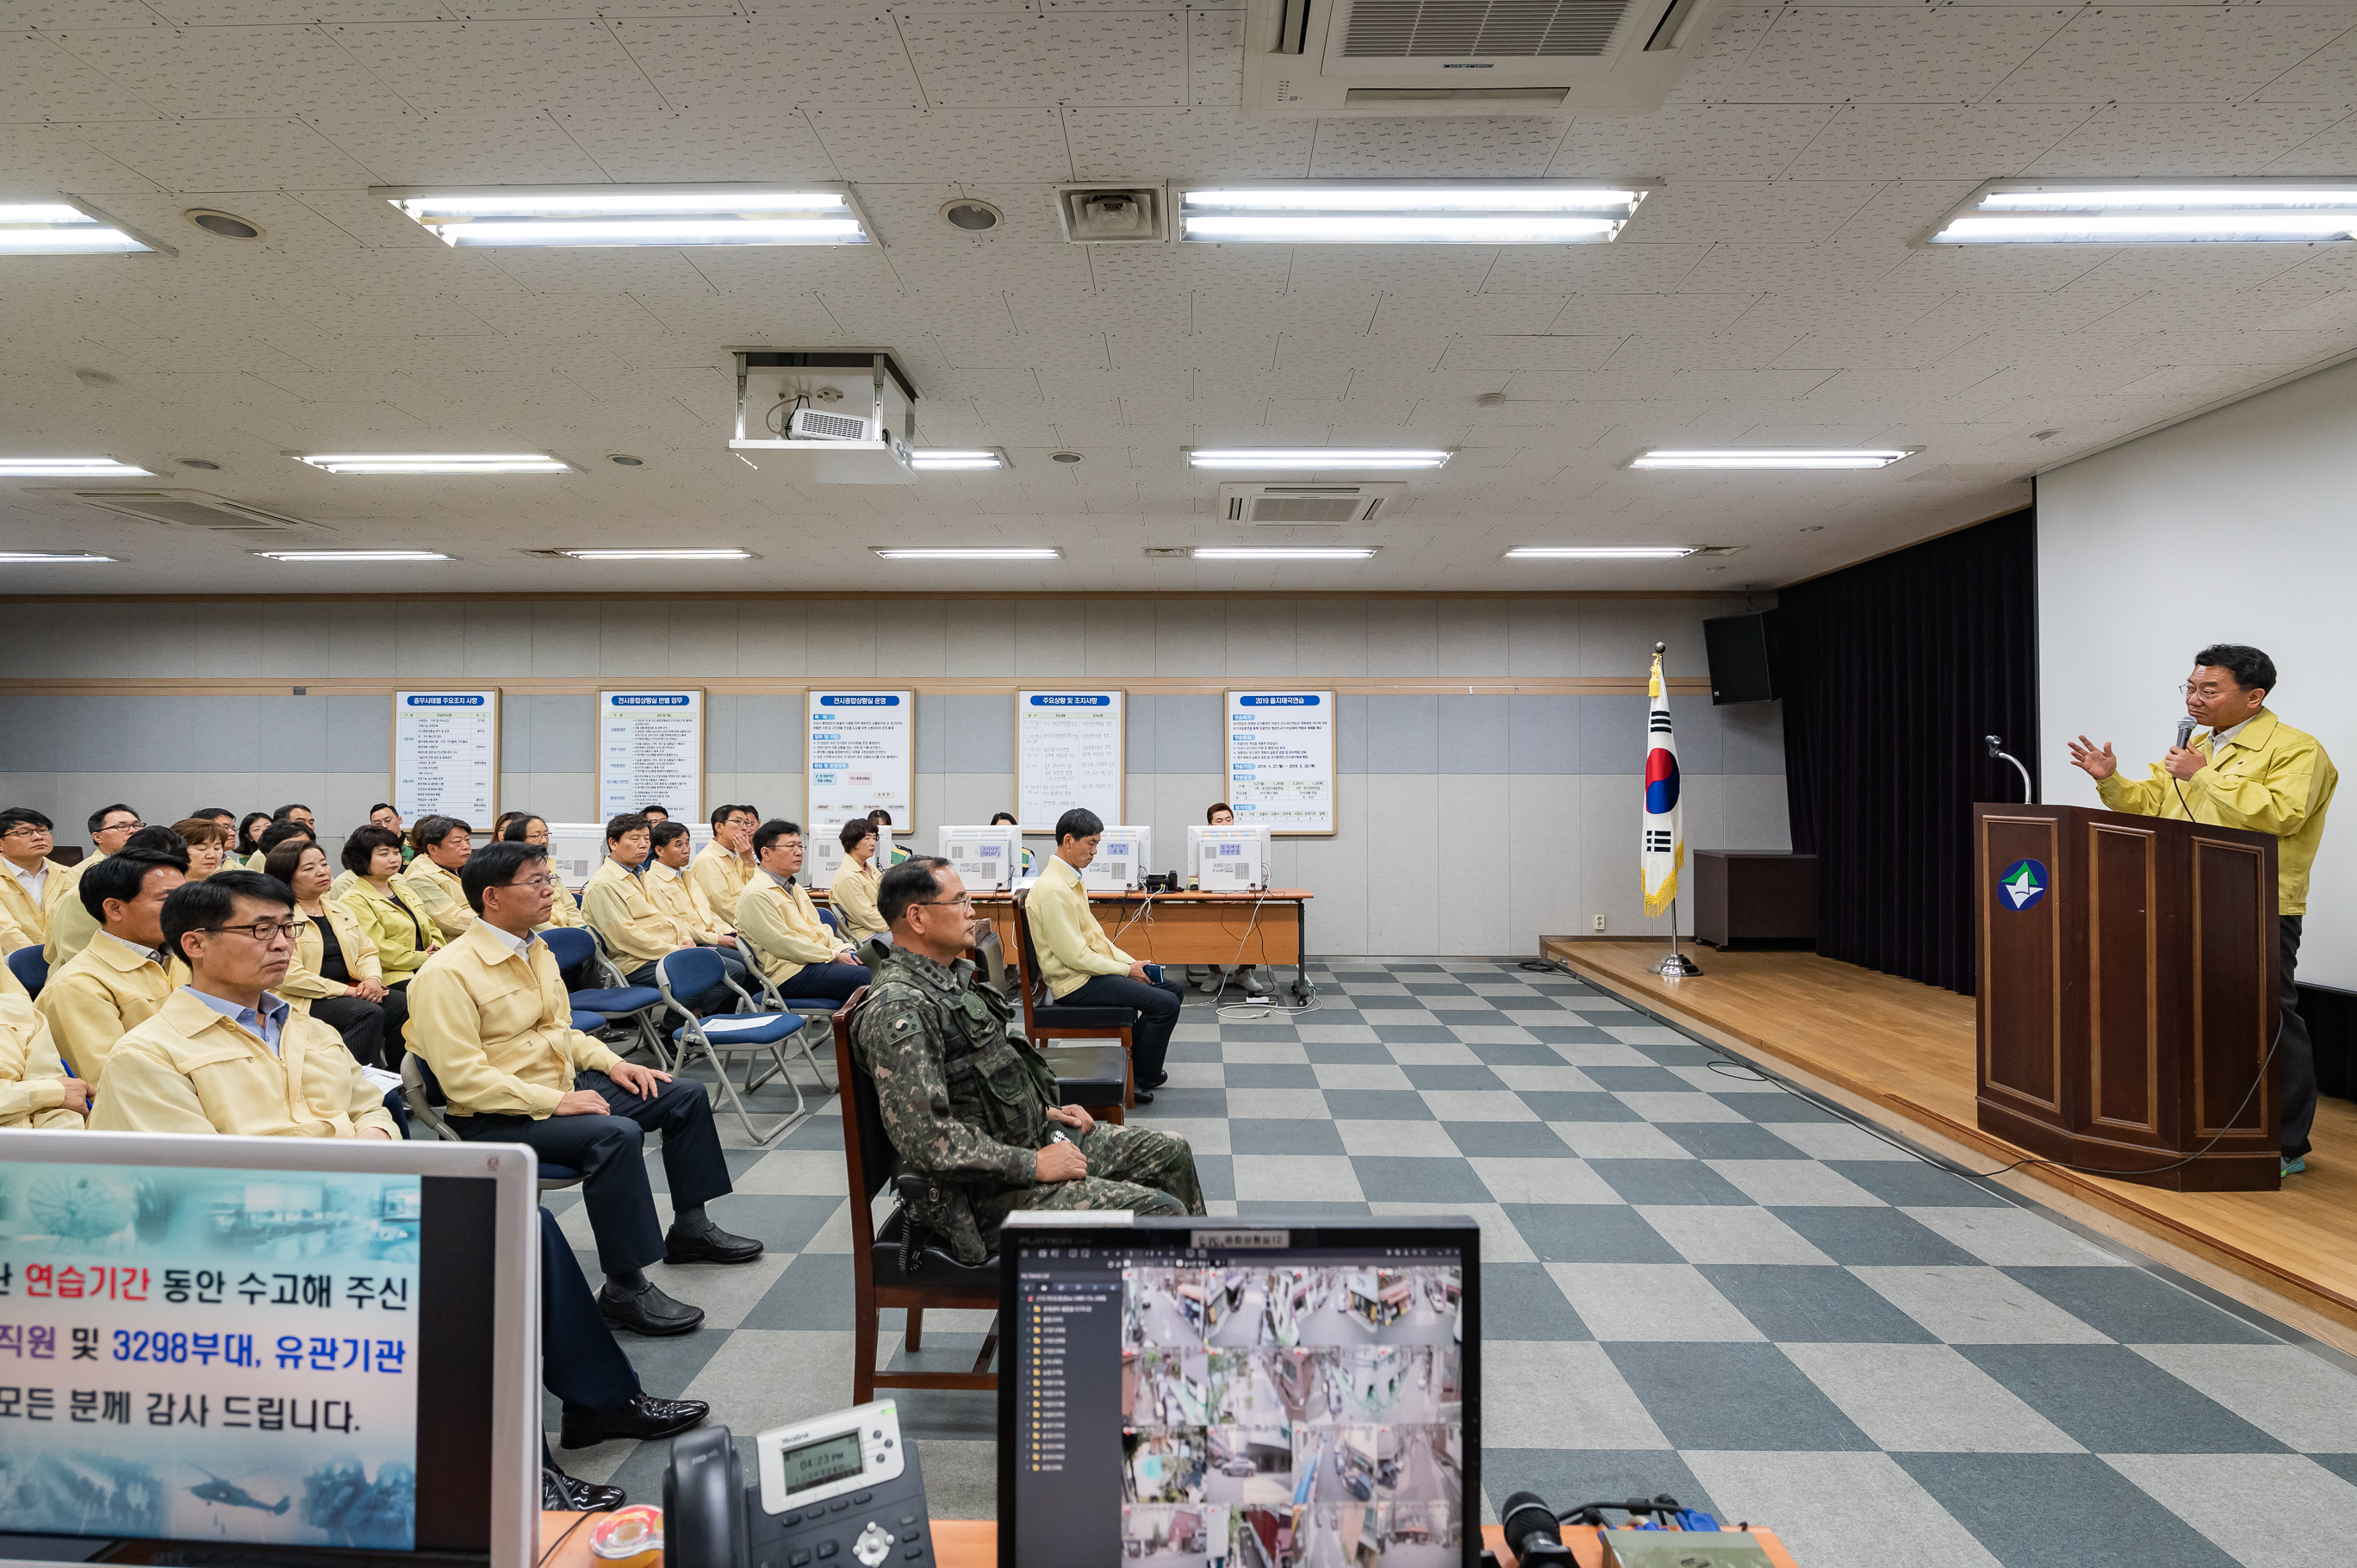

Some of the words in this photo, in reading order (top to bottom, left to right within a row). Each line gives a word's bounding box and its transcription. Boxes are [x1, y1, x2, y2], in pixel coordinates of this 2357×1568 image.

[25, 1263, 150, 1302] 연습기간
[163, 1269, 225, 1305] 동안
[237, 1272, 332, 1309] 수고해
[346, 1275, 408, 1311] 주신
[72, 1328, 99, 1361] 및
[113, 1330, 261, 1368] 3298부대,
[275, 1335, 406, 1374] 유관기관
[0, 1386, 55, 1420] 모든
[70, 1389, 131, 1424] 분께
[146, 1392, 209, 1427] 감사
[223, 1395, 361, 1433] 드립니다.
[800, 1454, 829, 1471] 04:23
[831, 1452, 844, 1461] PM
